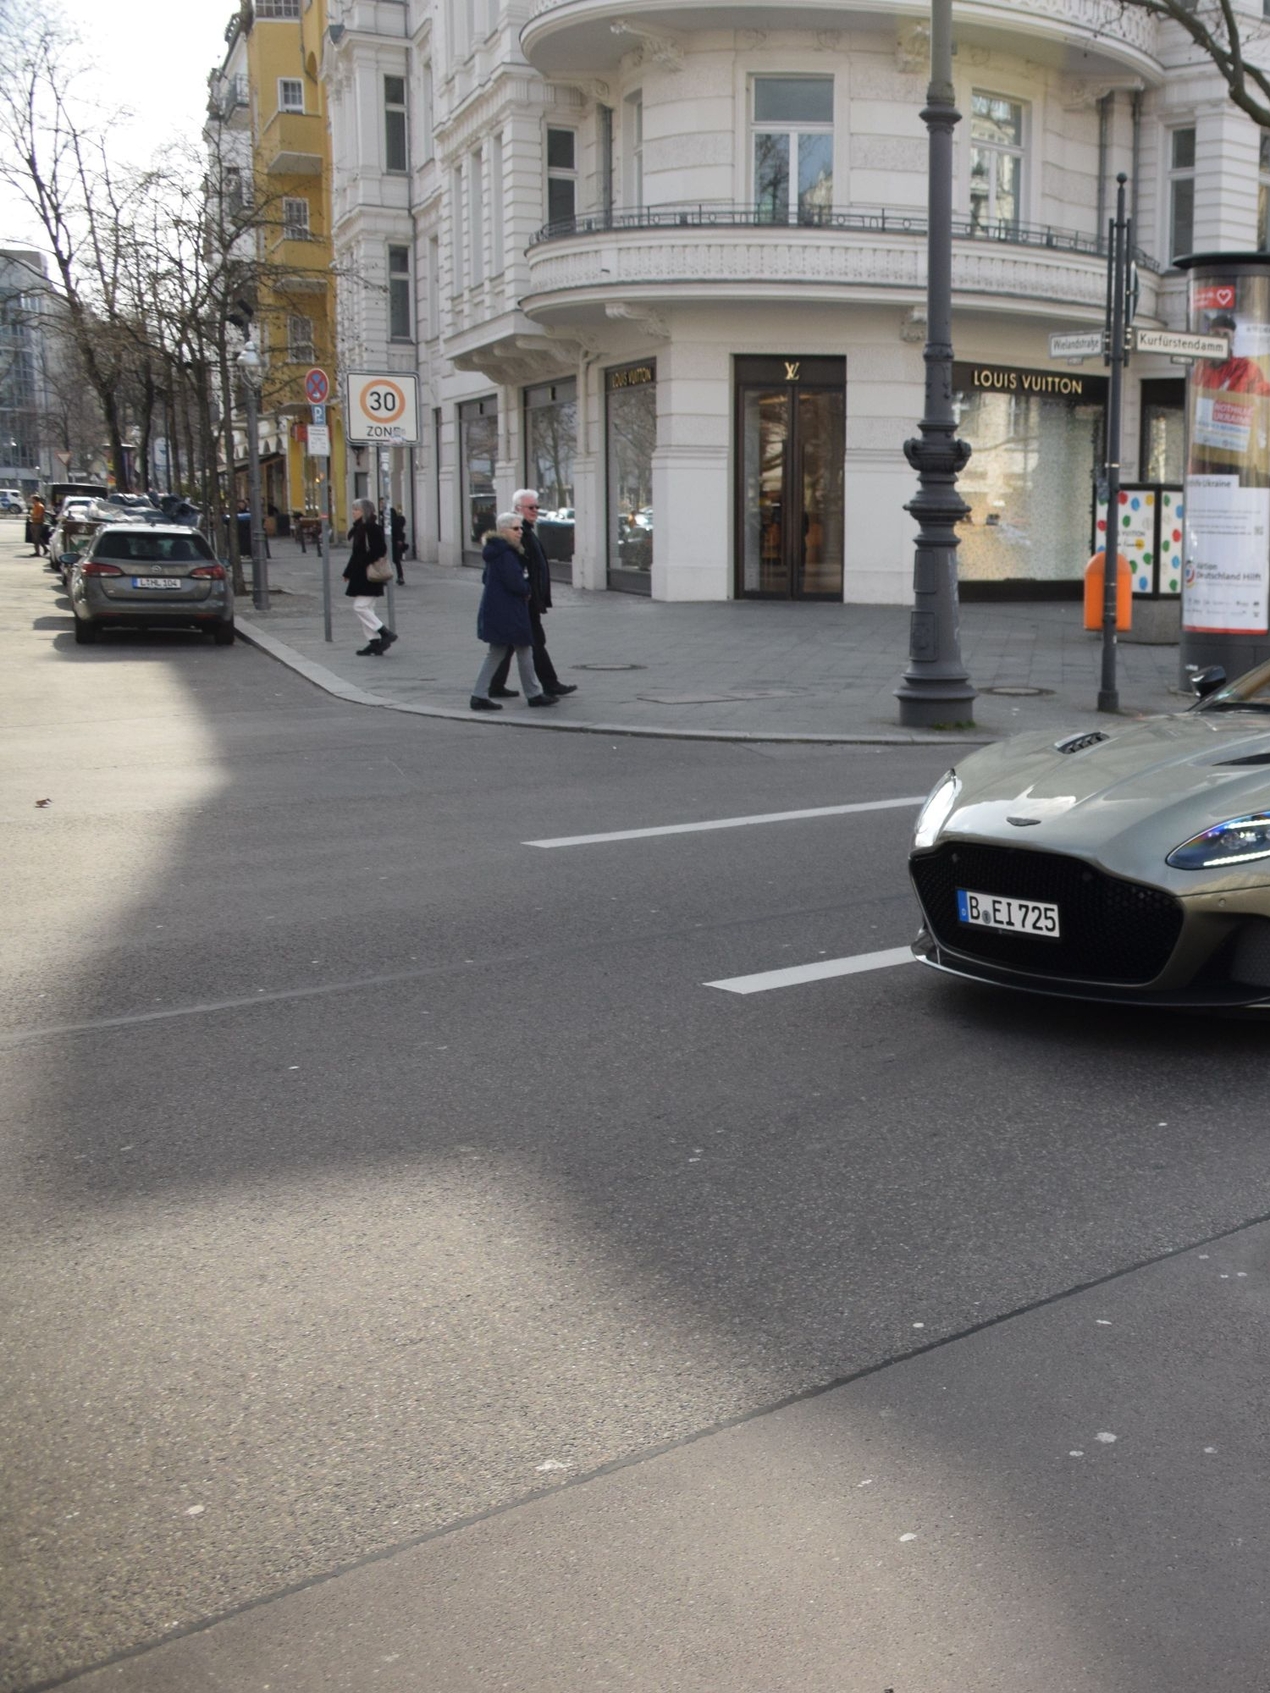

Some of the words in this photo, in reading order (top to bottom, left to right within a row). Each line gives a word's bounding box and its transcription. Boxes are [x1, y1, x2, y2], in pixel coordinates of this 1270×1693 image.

[1139, 334, 1224, 352] Kurfürstendamm
[974, 369, 1017, 389] LOUIS
[1021, 374, 1083, 395] VUITTON
[369, 391, 396, 412] 30
[1243, 572, 1262, 581] Hilft
[969, 895, 981, 920] B
